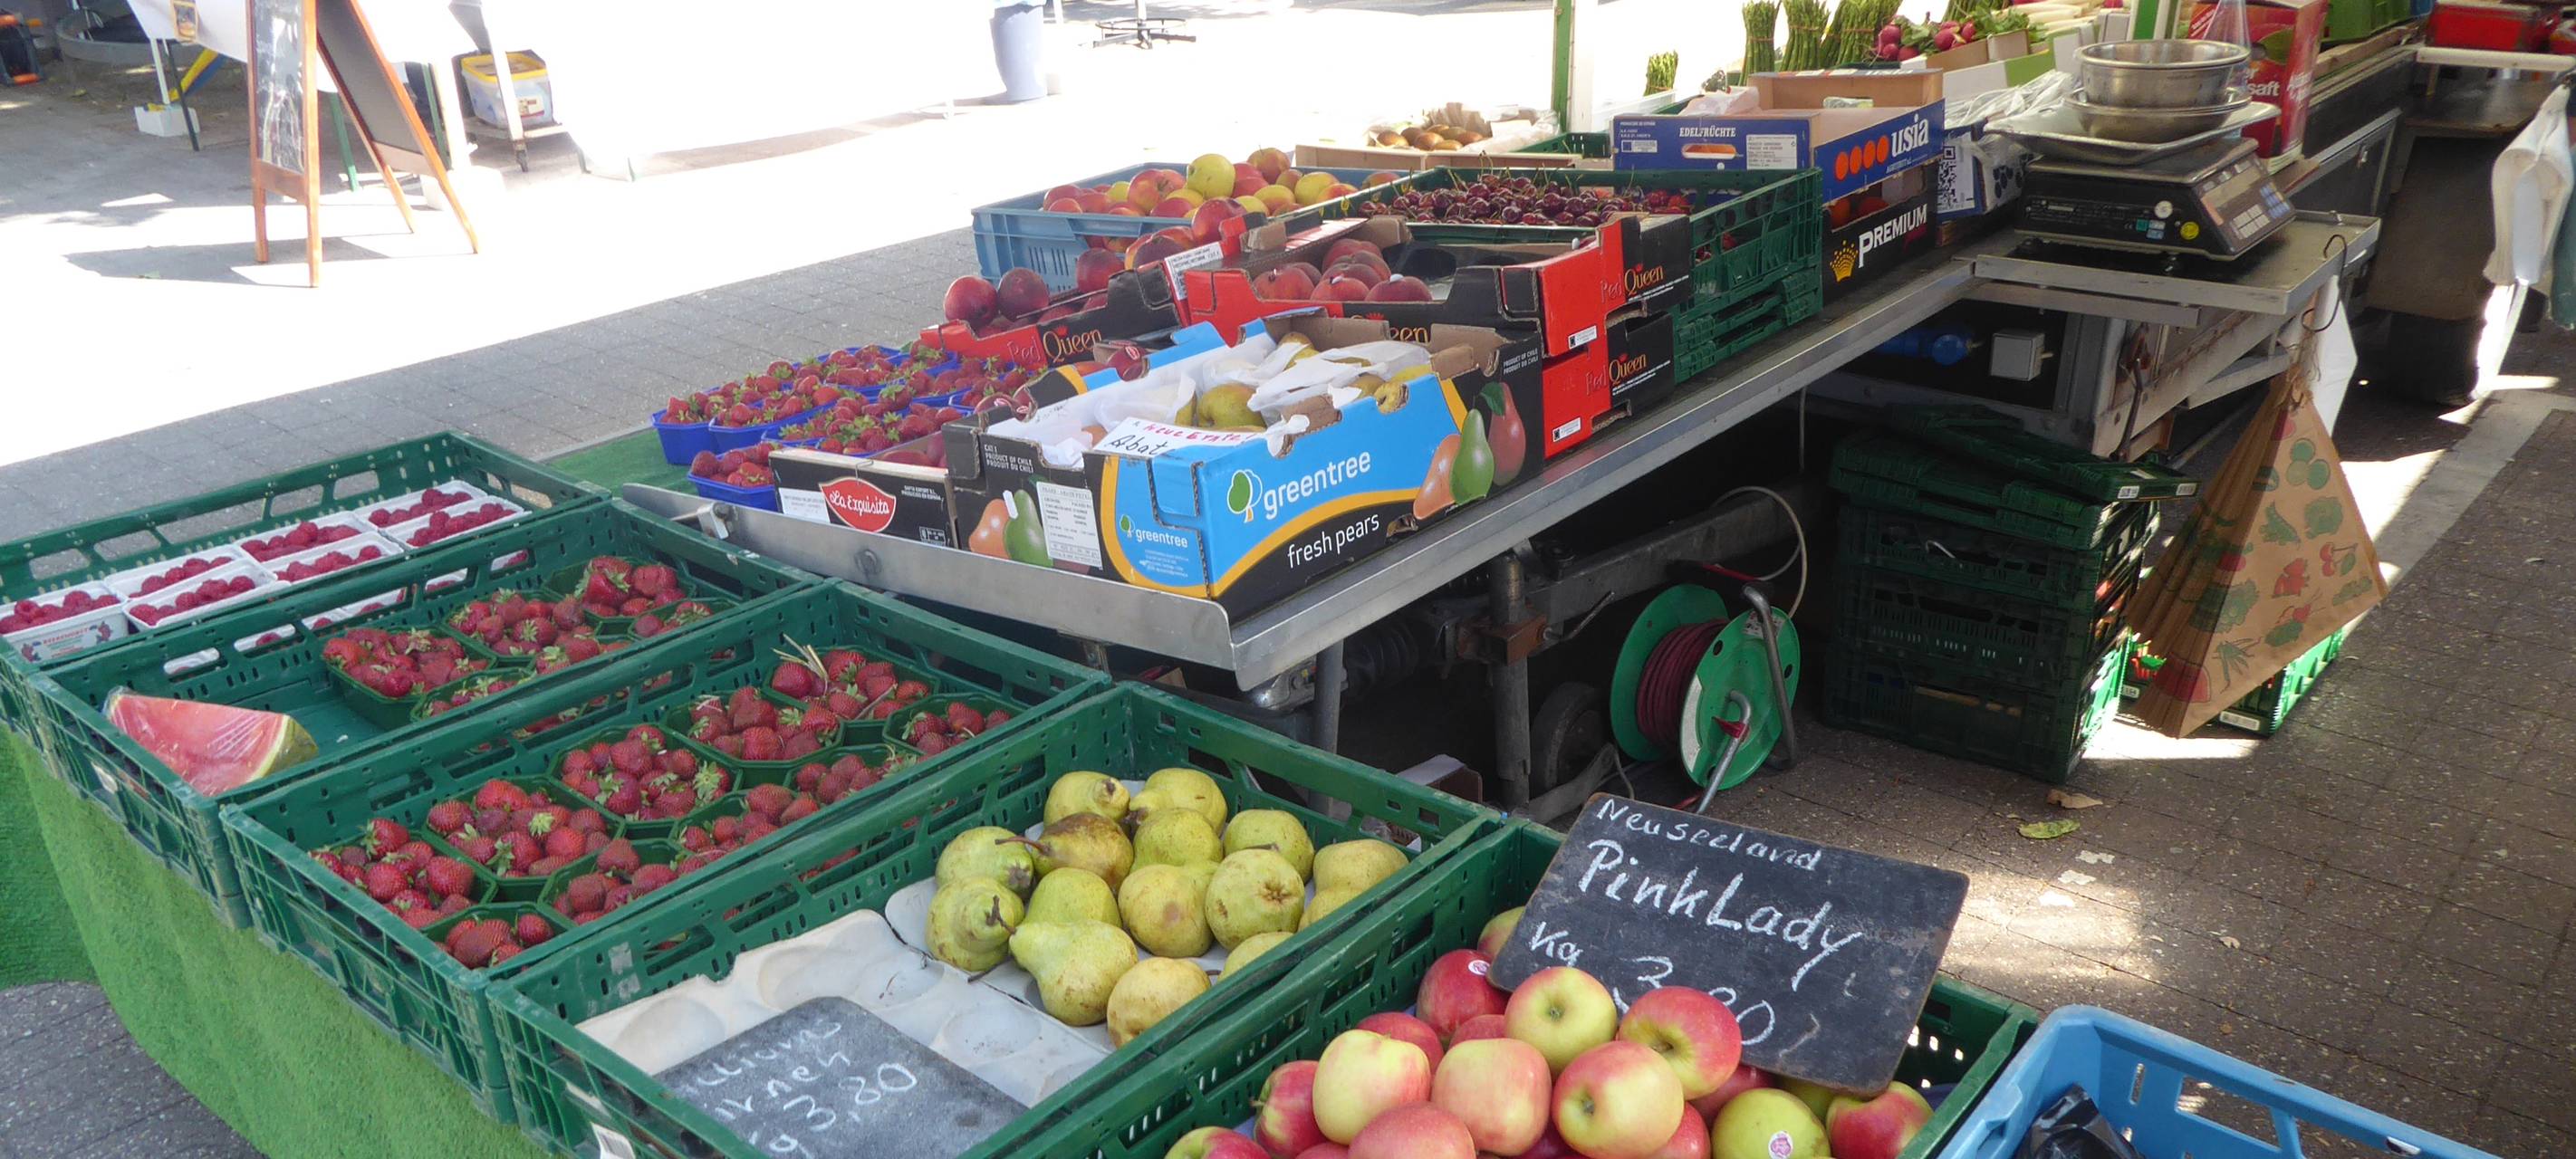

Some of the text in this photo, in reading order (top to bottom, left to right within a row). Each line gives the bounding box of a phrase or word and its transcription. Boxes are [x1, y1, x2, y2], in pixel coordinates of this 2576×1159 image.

[1679, 125, 1736, 138] EDELFRÜCHTE
[1858, 203, 1927, 269] PREMIUM
[1624, 265, 1665, 296] Queen
[1043, 329, 1102, 363] Queen
[1609, 354, 1647, 386] Queen
[1264, 451, 1371, 520] greentree
[829, 489, 847, 509] La
[847, 494, 890, 517] Exquisita
[1135, 528, 1188, 549] greentree
[1287, 513, 1379, 569] fresh pears
[1597, 798, 1822, 872] Neuseeland
